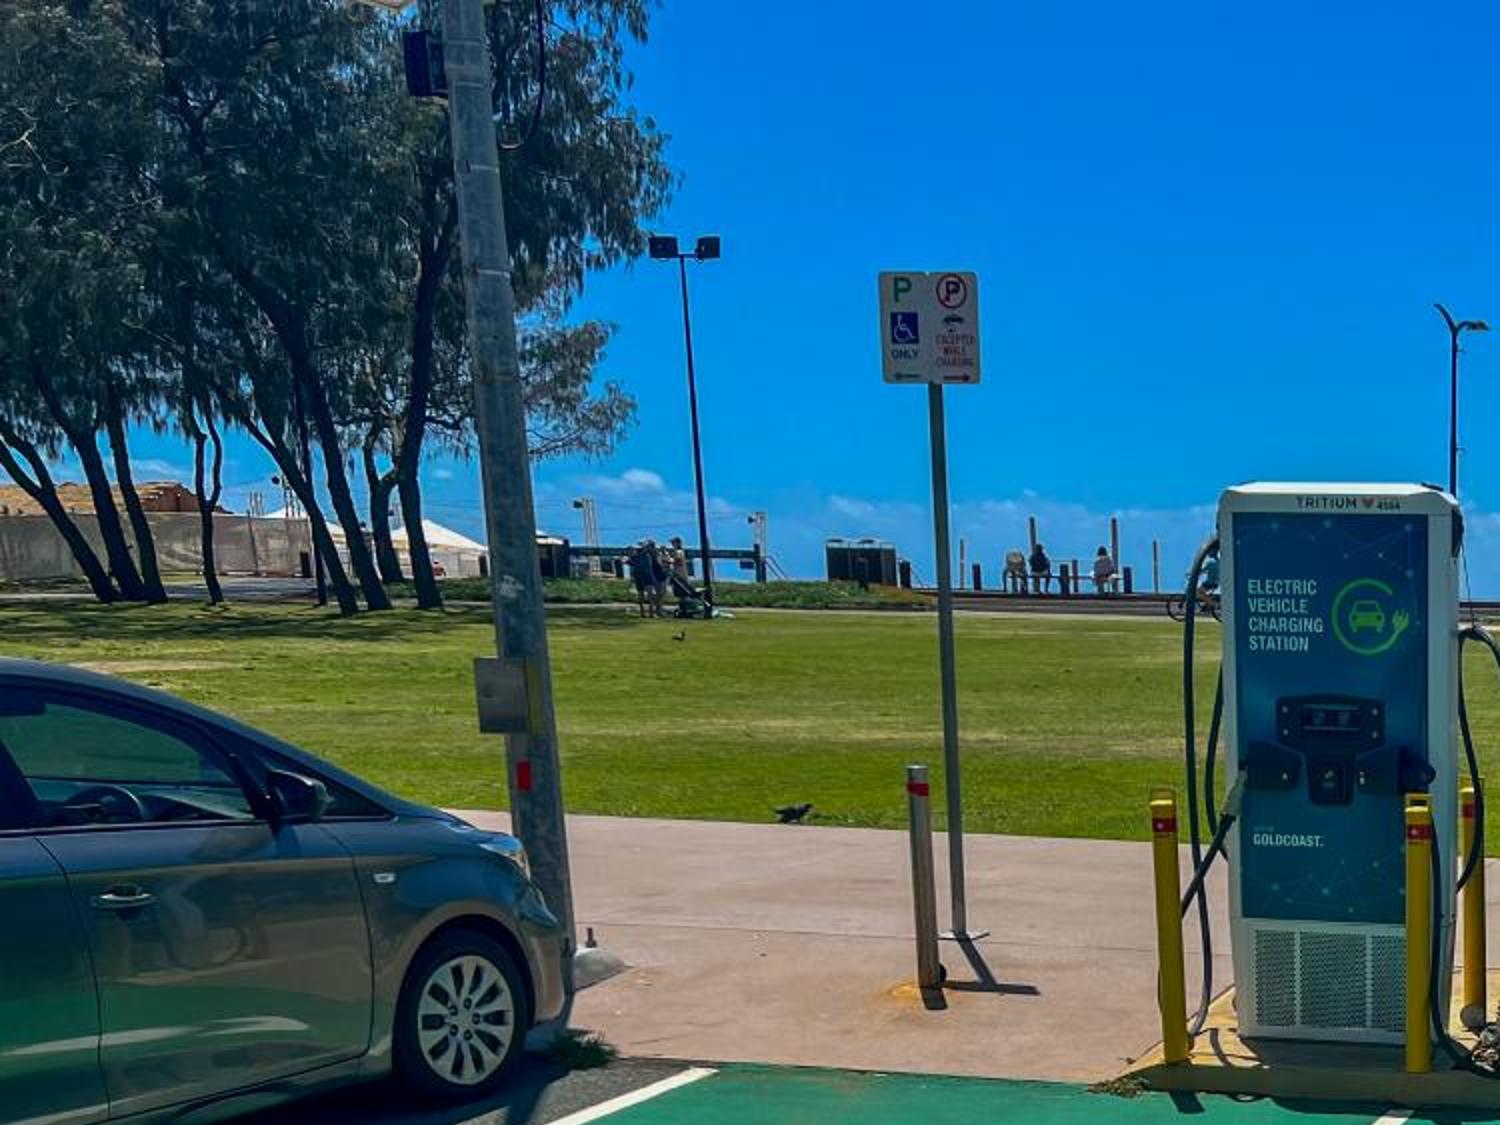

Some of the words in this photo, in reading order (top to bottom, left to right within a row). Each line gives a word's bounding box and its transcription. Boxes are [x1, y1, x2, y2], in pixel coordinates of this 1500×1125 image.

[894, 277, 912, 302] P
[1297, 497, 1357, 508] TRITIUM
[1248, 580, 1317, 594] ELECTRIC
[1248, 598, 1308, 614] VEHICLE
[1249, 617, 1323, 633] CHARGING
[1249, 636, 1309, 651] STATION
